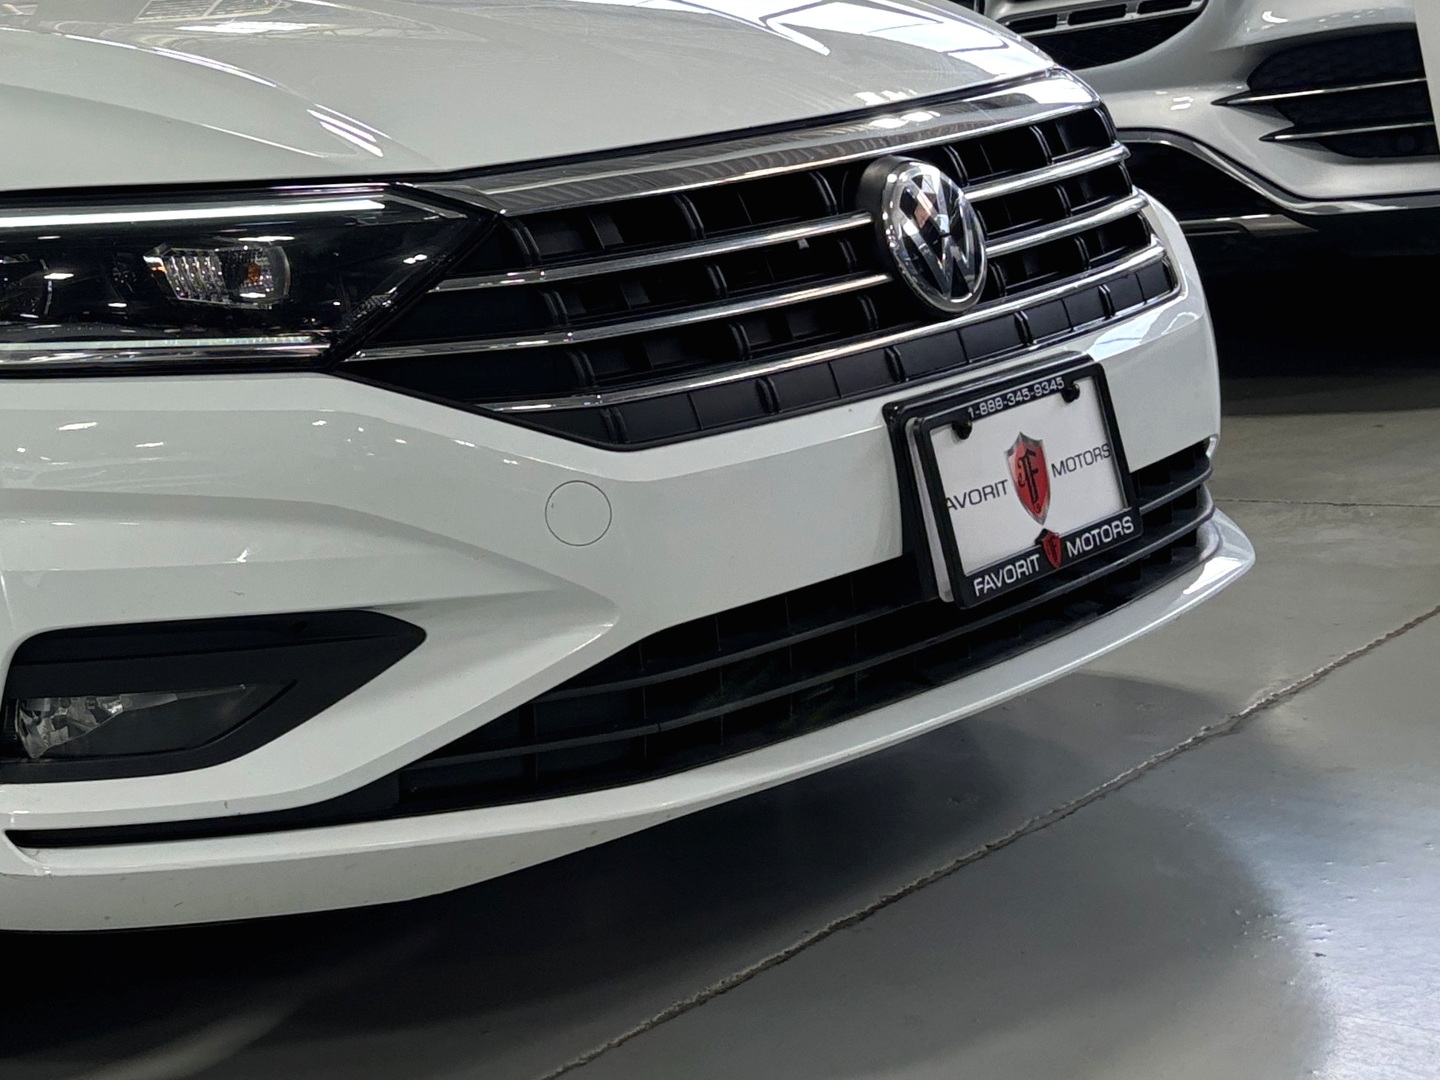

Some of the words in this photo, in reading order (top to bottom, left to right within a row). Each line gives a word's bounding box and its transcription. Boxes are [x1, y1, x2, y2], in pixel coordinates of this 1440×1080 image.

[967, 376, 1065, 419] 1-888-345-9345
[1051, 443, 1110, 478] MOTORS
[973, 554, 1040, 597] FAVORIT
[1066, 516, 1135, 558] MOTORS
